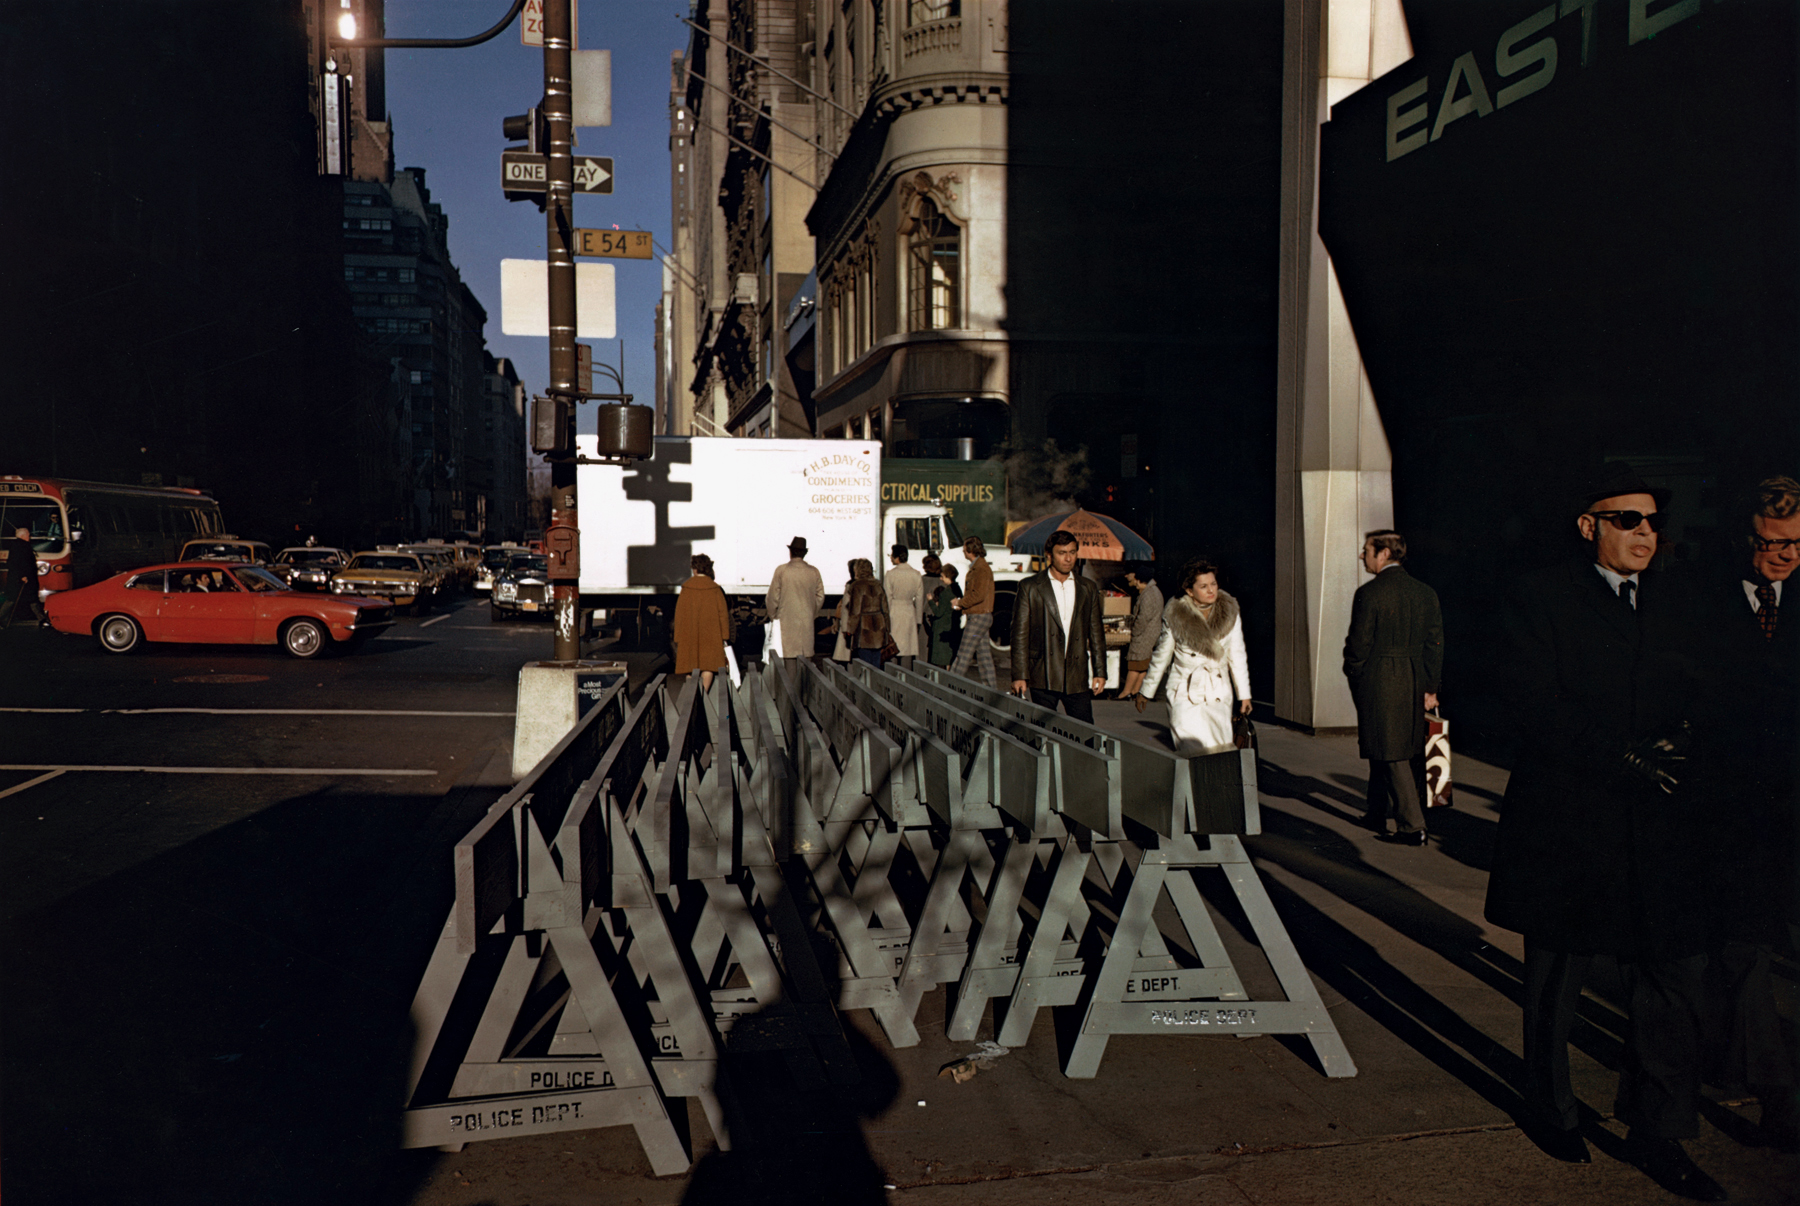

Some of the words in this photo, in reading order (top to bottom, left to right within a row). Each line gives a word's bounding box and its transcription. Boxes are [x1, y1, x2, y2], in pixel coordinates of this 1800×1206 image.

[511, 164, 544, 180] ONE
[573, 166, 598, 182] AY
[583, 232, 593, 252] E
[601, 233, 627, 254] 54
[636, 235, 648, 246] ST
[14, 484, 37, 492] COACH
[807, 476, 873, 487] CONDIMENTS
[811, 494, 871, 504] GROCERIES
[881, 482, 933, 502] CTRICAL
[937, 484, 994, 502] SUPPLIES
[951, 724, 973, 758] CROSS
[1151, 1009, 1210, 1025] POLICE
[531, 1071, 595, 1088] POLICE
[450, 1108, 523, 1132] POLICE
